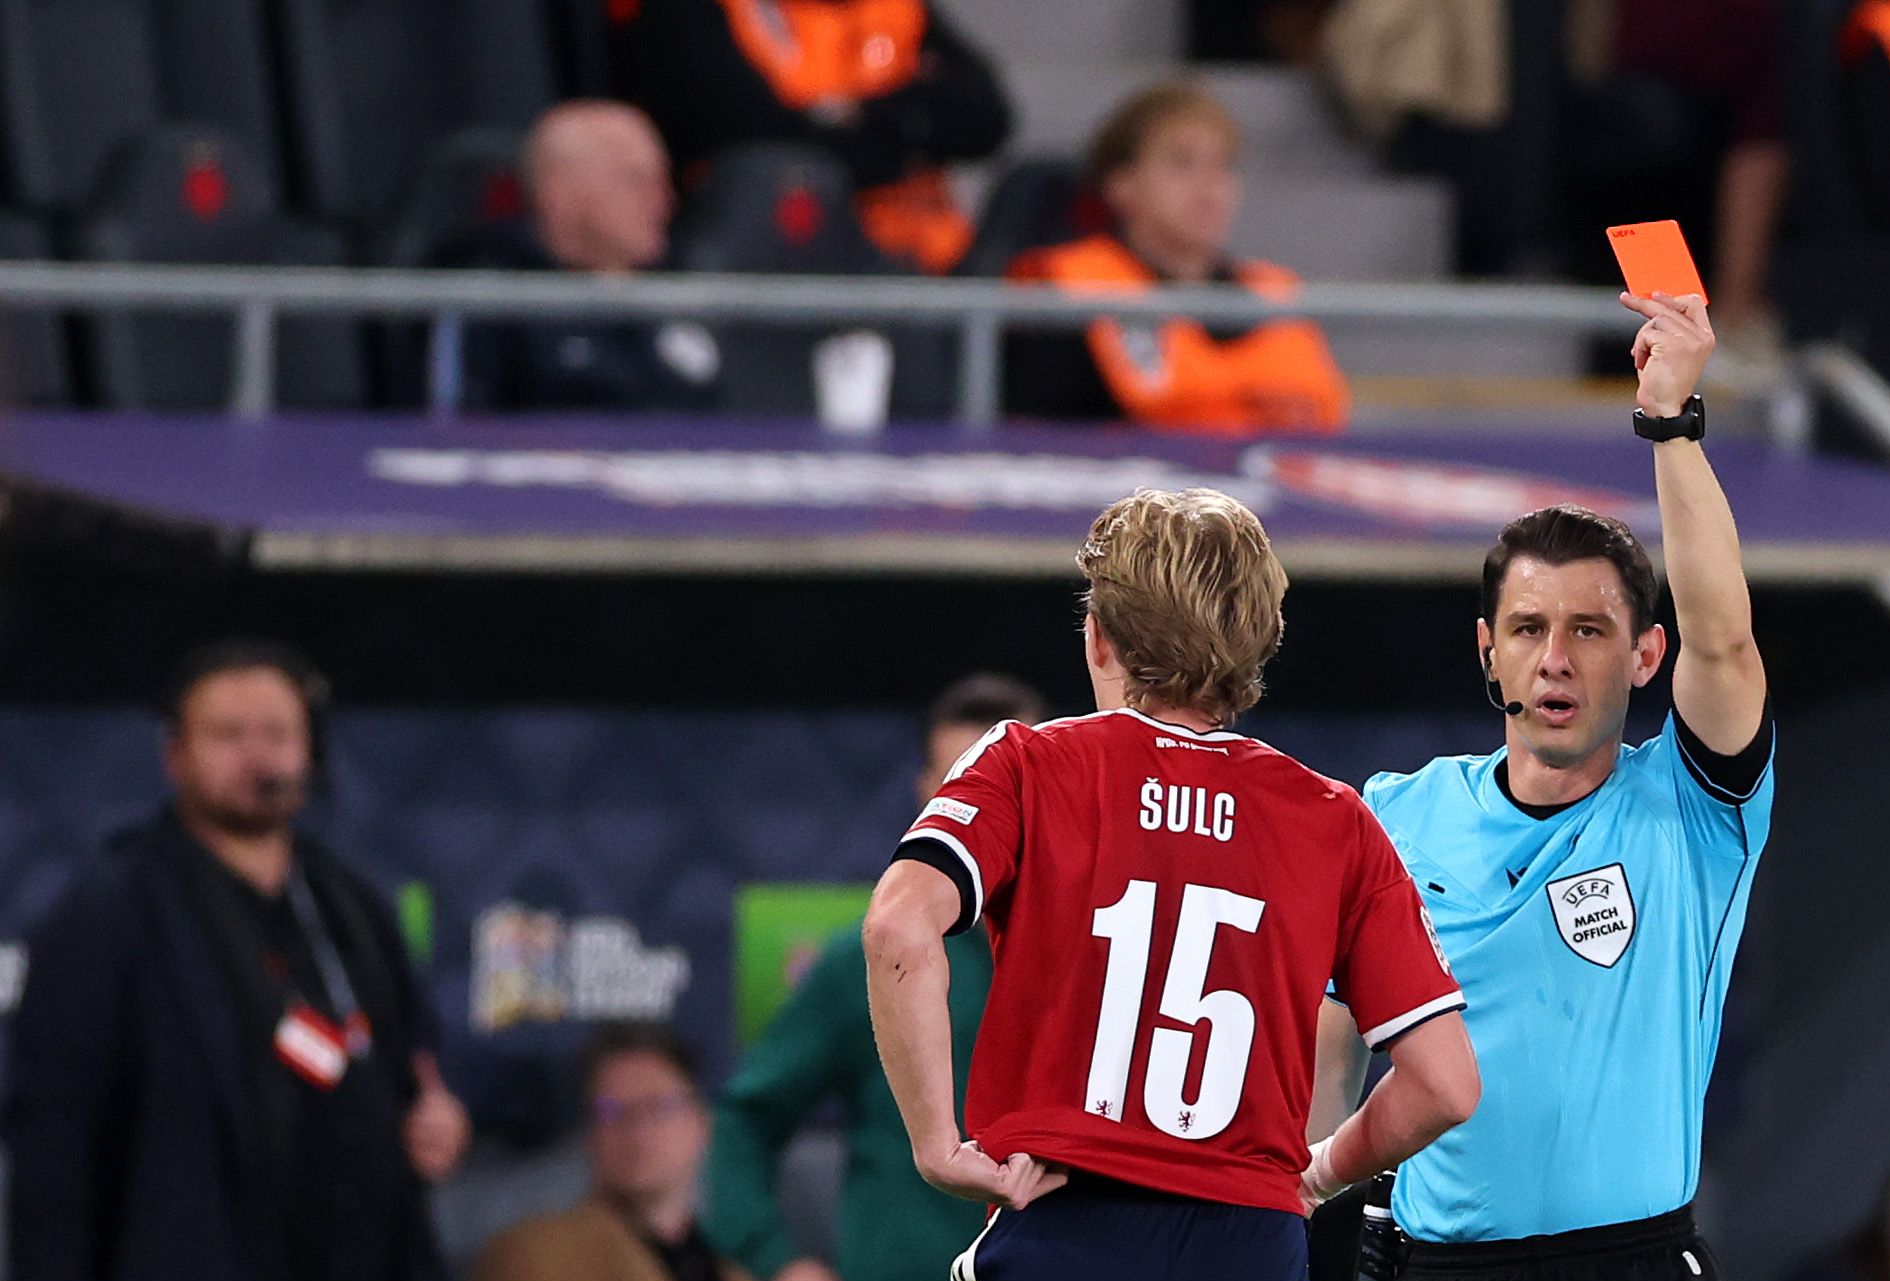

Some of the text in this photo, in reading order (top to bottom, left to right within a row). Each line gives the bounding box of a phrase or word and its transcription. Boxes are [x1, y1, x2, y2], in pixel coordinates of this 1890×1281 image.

[1612, 229, 1635, 238] UEFA
[1139, 776, 1236, 842] ŠULC
[1566, 882, 1610, 904] UEFA
[1574, 907, 1618, 927] MATCH
[1572, 920, 1628, 943] OFFICIAL
[1084, 879, 1266, 1140] 15
